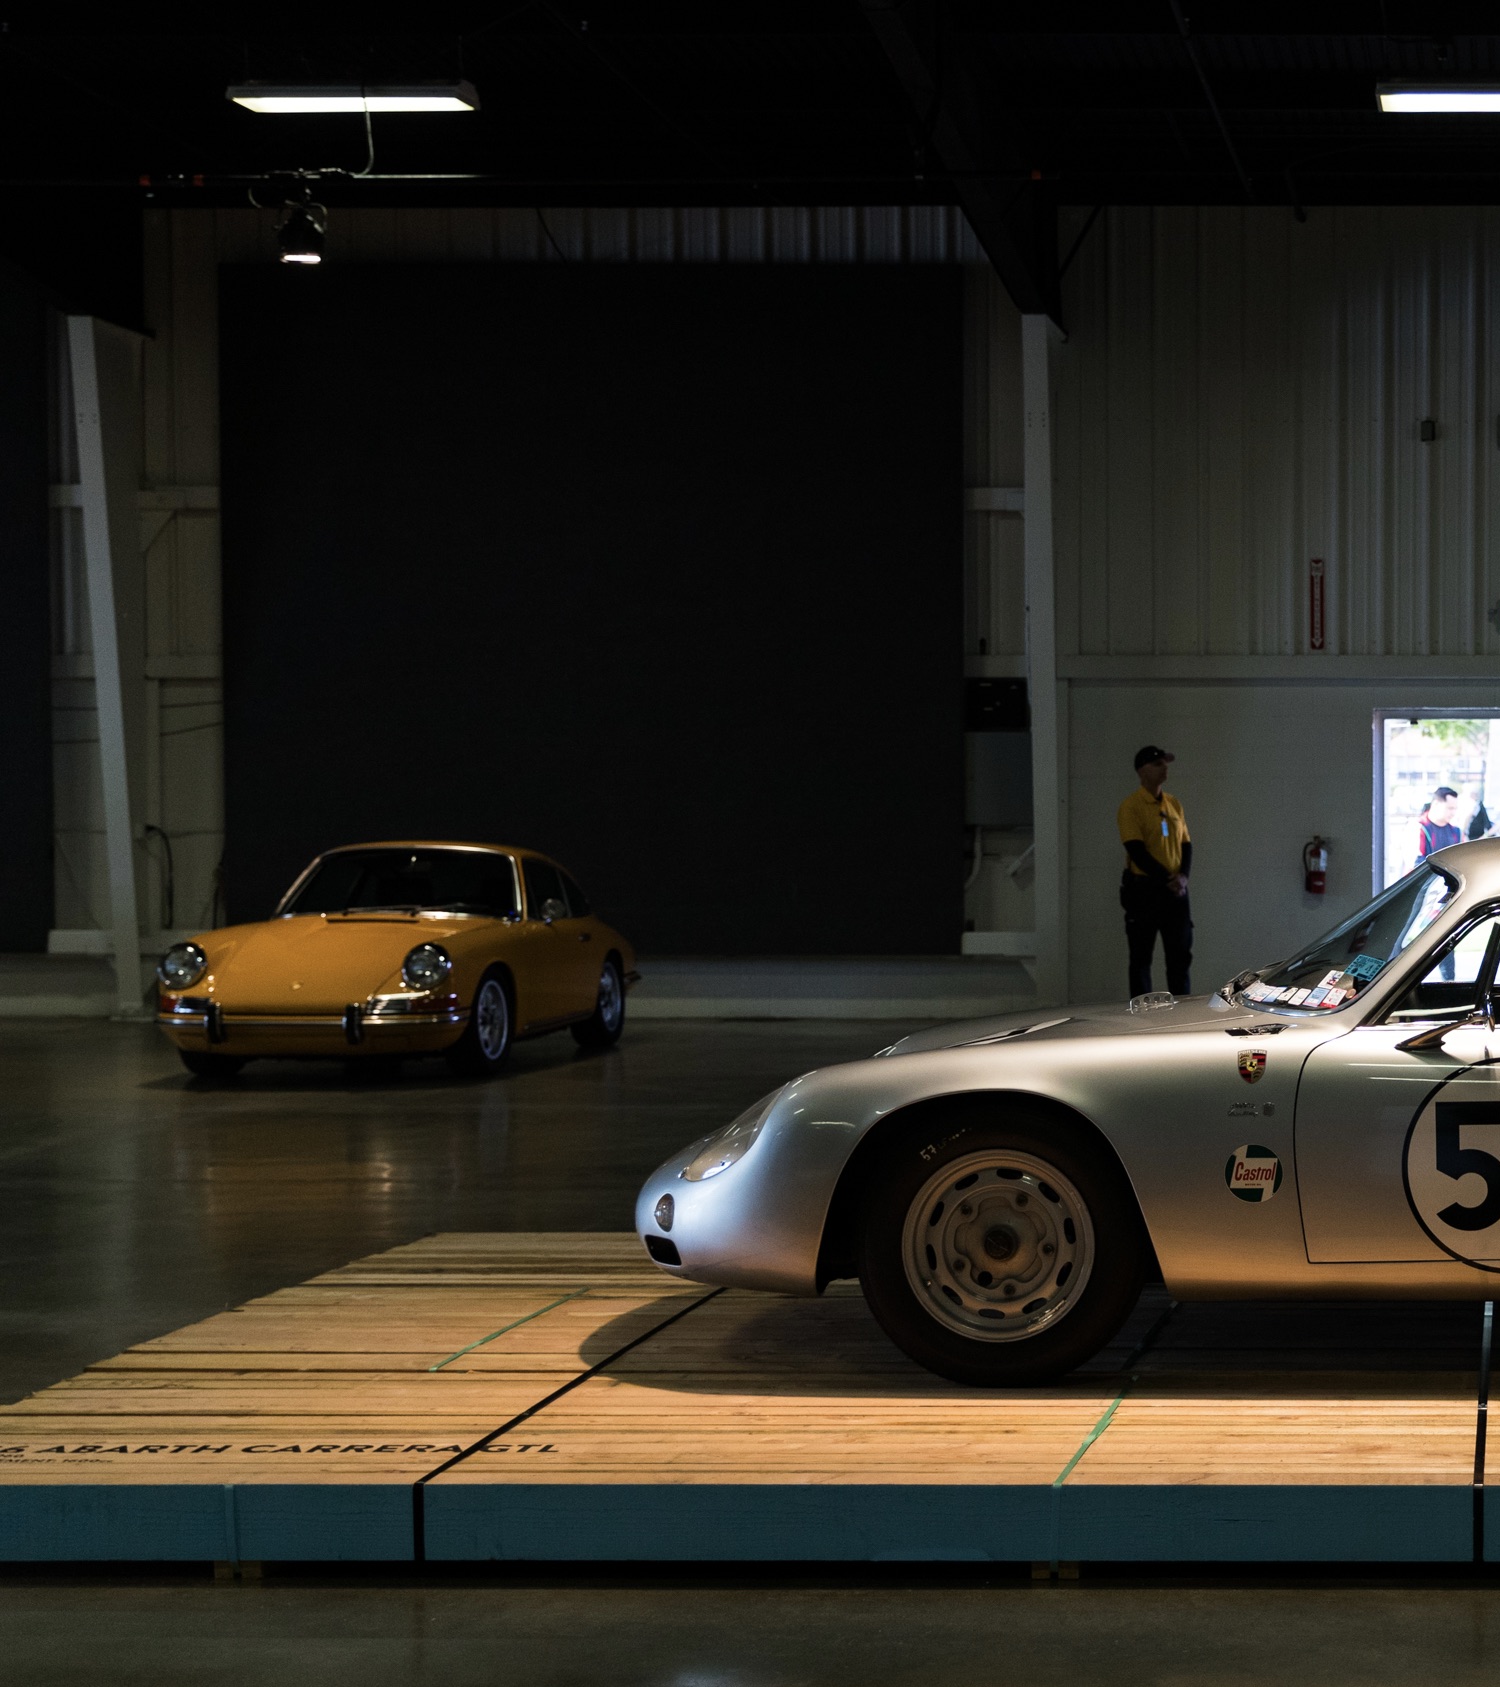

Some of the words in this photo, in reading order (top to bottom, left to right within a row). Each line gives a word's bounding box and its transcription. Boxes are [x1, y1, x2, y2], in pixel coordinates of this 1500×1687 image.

[1234, 1161, 1277, 1182] Castrol
[34, 1445, 233, 1454] ABARTH
[241, 1444, 464, 1454] CARRERA
[477, 1444, 561, 1453] GTL
